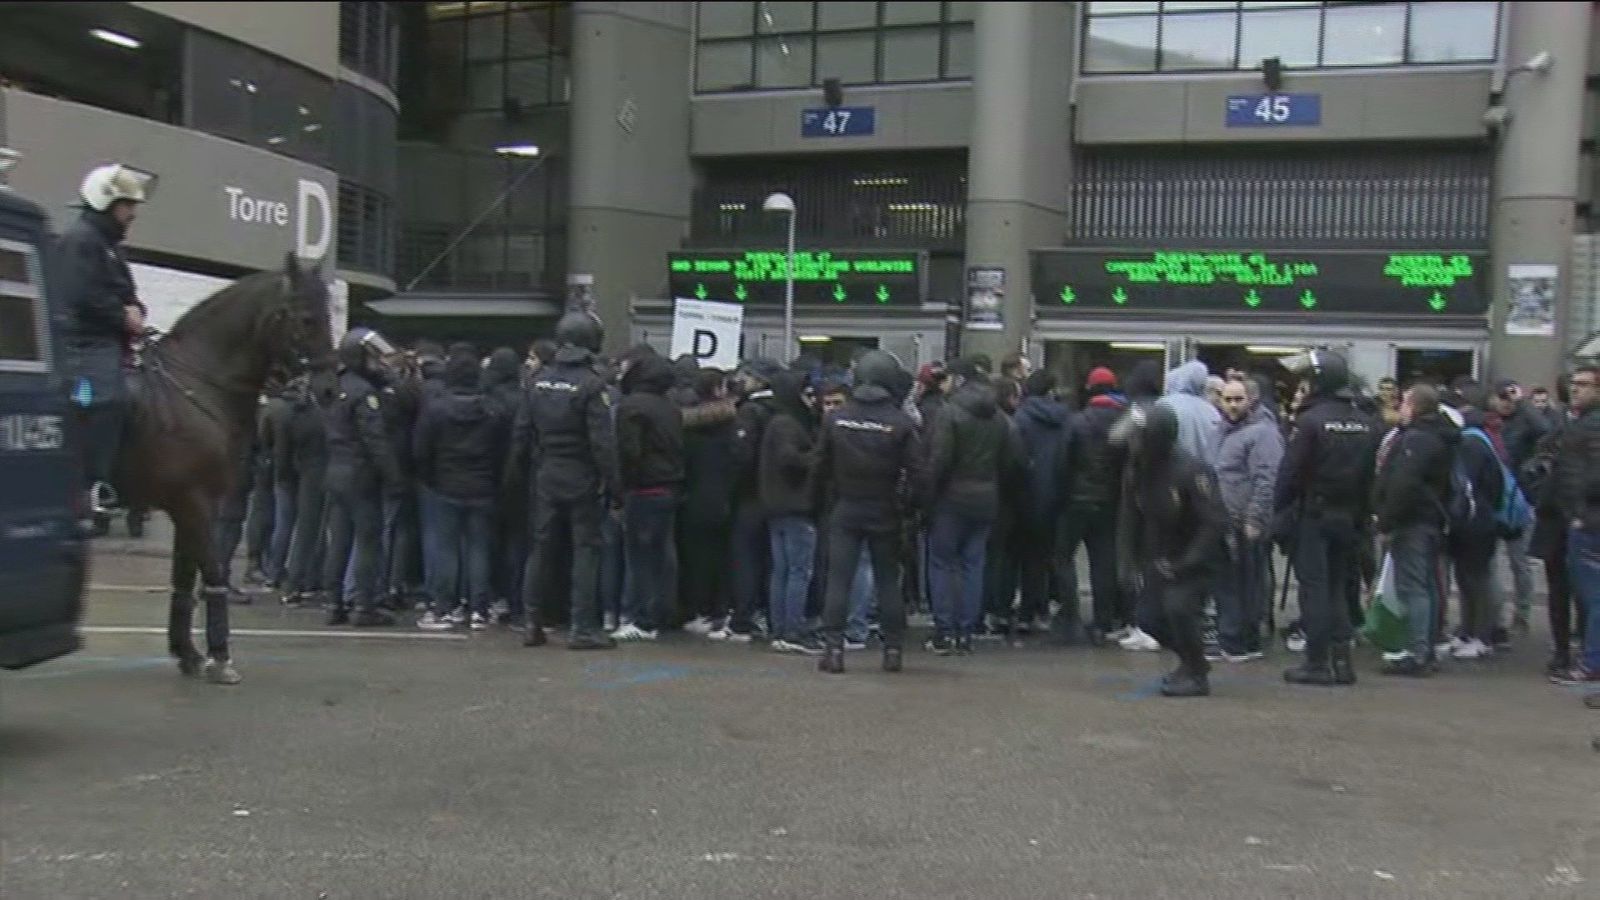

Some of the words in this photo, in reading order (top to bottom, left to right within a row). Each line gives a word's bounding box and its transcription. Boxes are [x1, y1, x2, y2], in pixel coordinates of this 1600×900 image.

[1255, 96, 1290, 121] 45
[823, 111, 852, 134] 47
[224, 186, 288, 225] Torre
[297, 179, 332, 260] D
[693, 329, 717, 359] D
